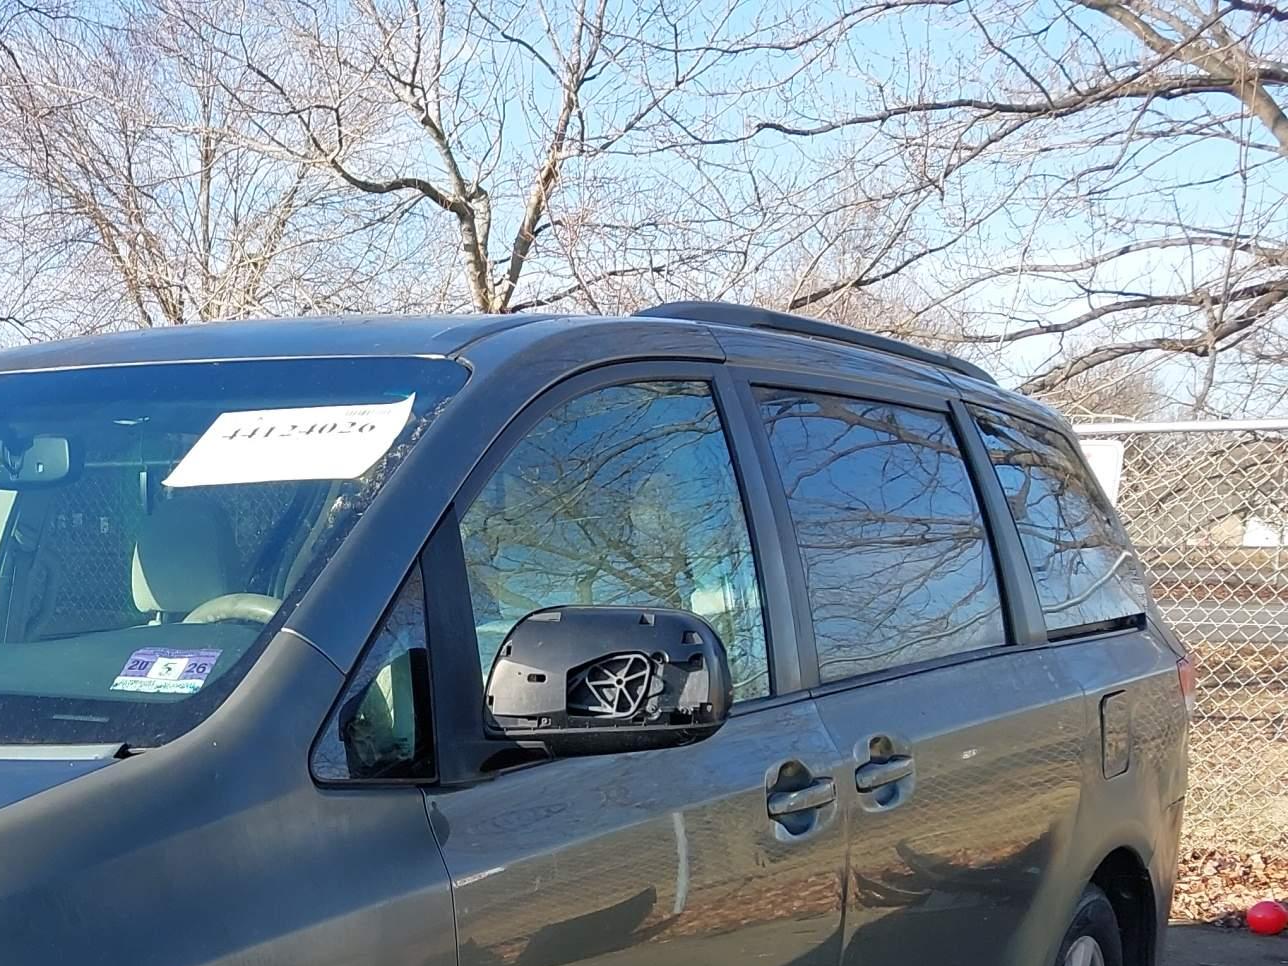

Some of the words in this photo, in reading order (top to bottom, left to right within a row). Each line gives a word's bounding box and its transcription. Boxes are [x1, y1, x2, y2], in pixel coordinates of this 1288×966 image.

[222, 421, 376, 439] 44124026
[127, 659, 149, 671] 20
[186, 662, 208, 674] 26
